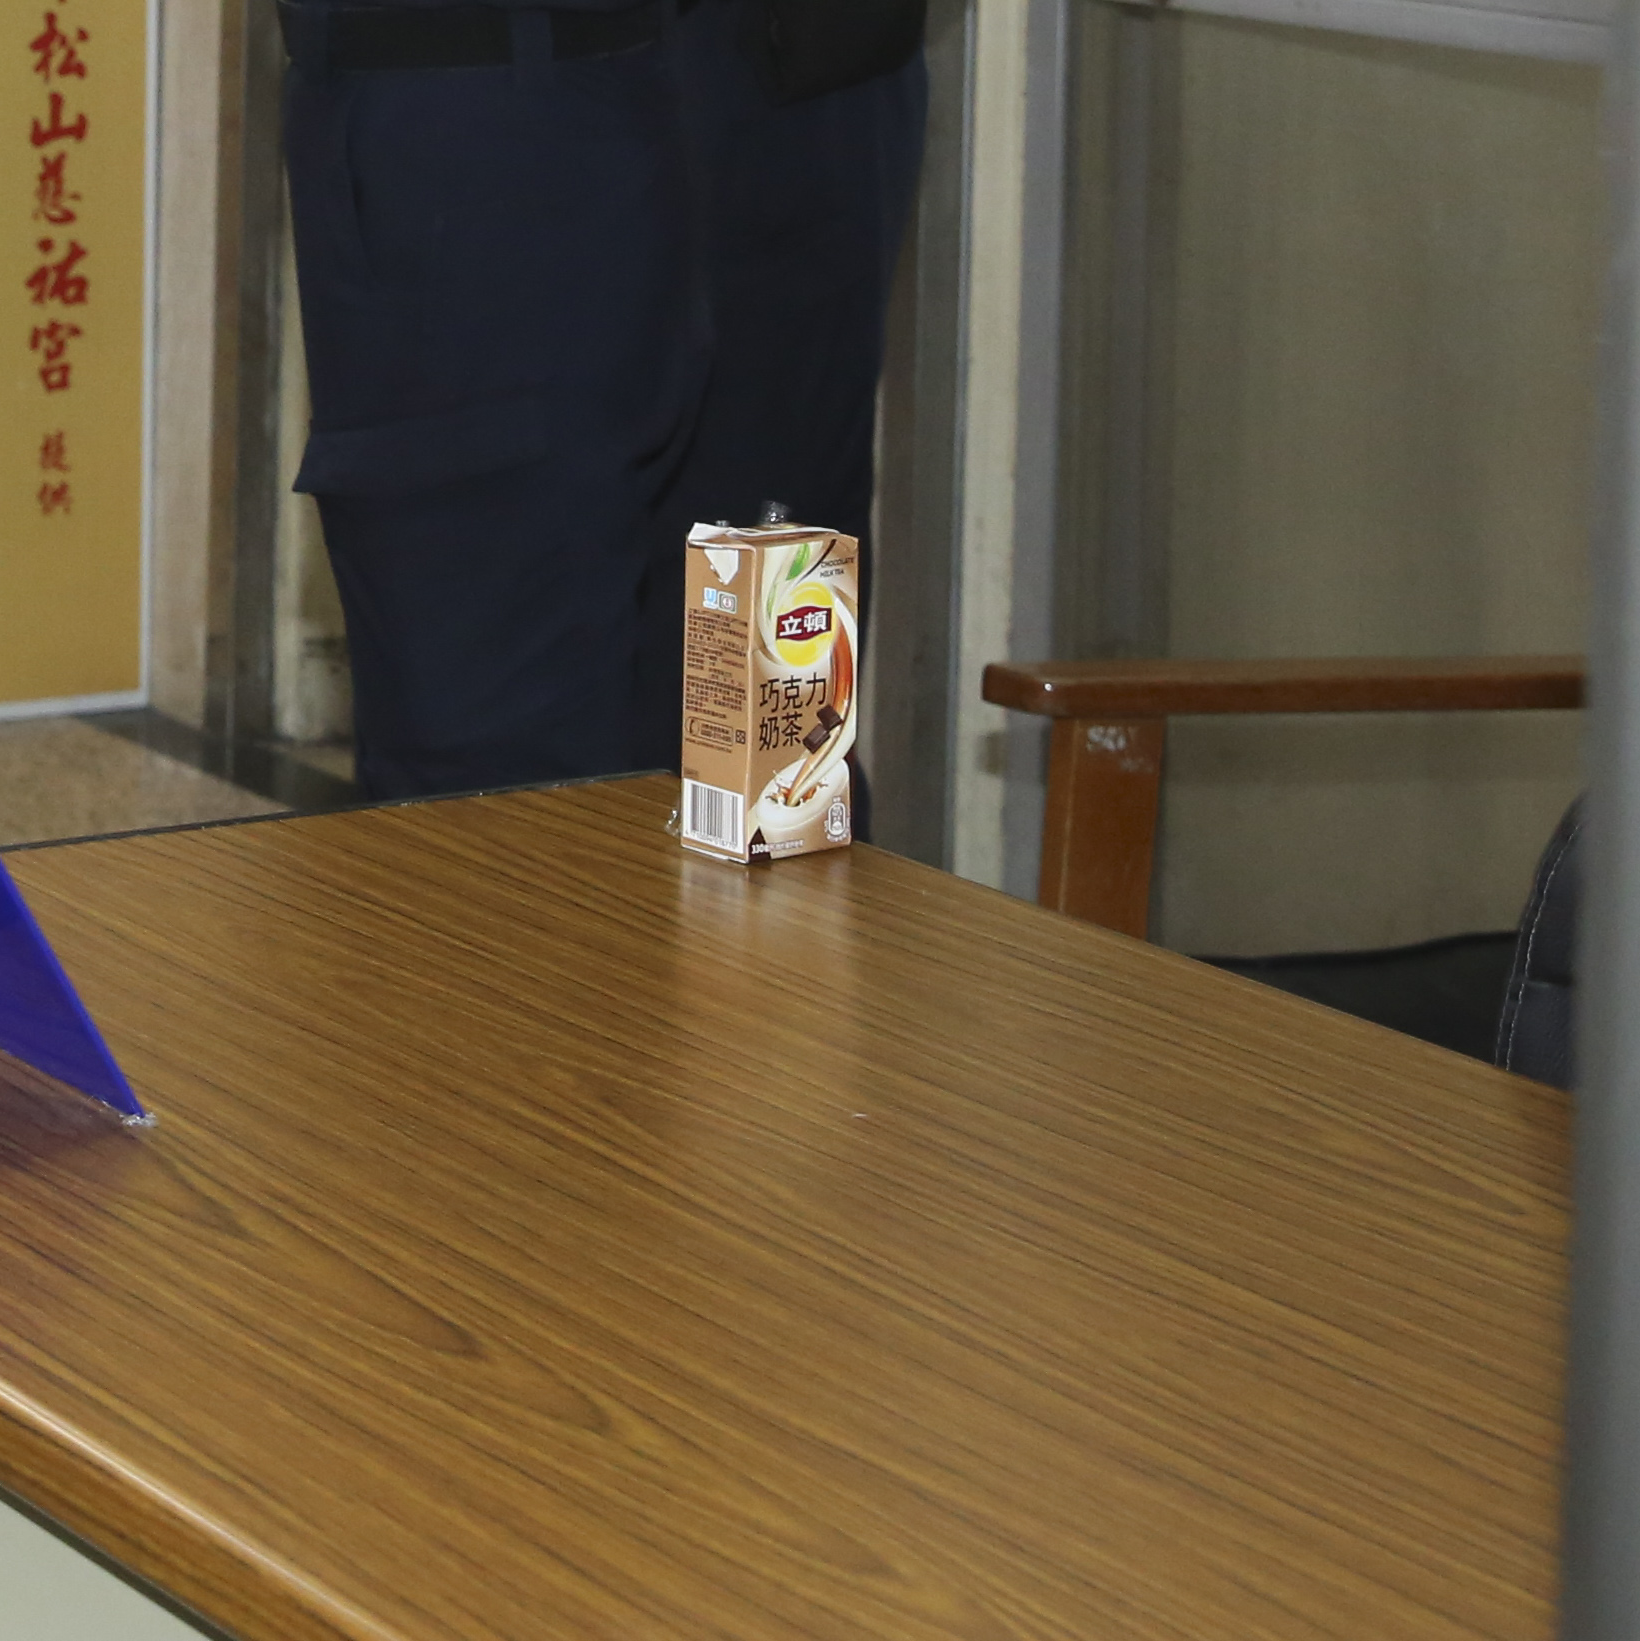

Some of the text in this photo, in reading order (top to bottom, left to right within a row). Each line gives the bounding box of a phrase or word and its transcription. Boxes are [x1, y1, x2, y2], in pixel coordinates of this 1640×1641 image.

[779, 610, 828, 637] 立頓
[759, 672, 826, 713] 巧克力
[759, 711, 803, 752] 奶茶
